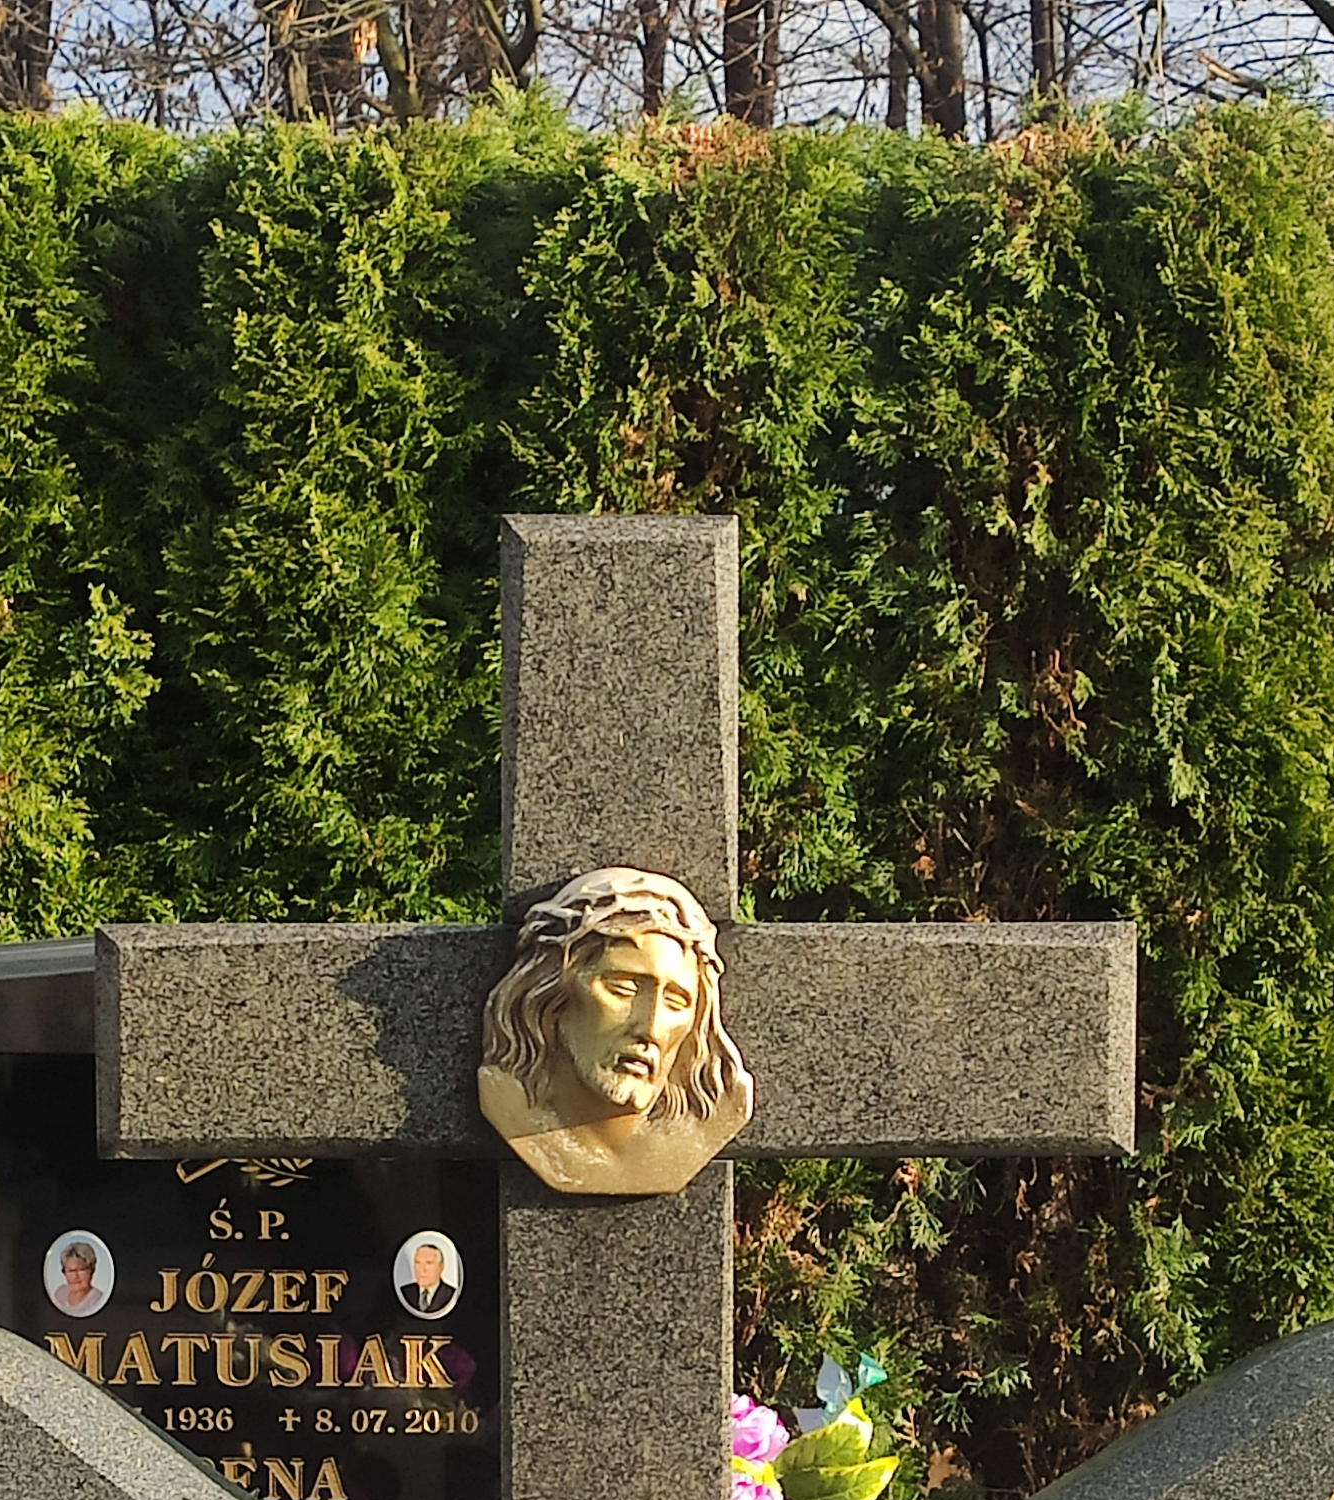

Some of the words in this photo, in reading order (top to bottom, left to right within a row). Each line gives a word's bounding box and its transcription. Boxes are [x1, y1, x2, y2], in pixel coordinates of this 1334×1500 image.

[209, 1199, 243, 1240] Ś.
[258, 1209, 291, 1241] P.
[150, 1253, 349, 1313] JÓZEF
[44, 1331, 455, 1389] MATUSIAK
[163, 1406, 234, 1432] 1936
[314, 1408, 341, 1433] 8.
[351, 1409, 396, 1434] 07.
[404, 1409, 479, 1434] 2010
